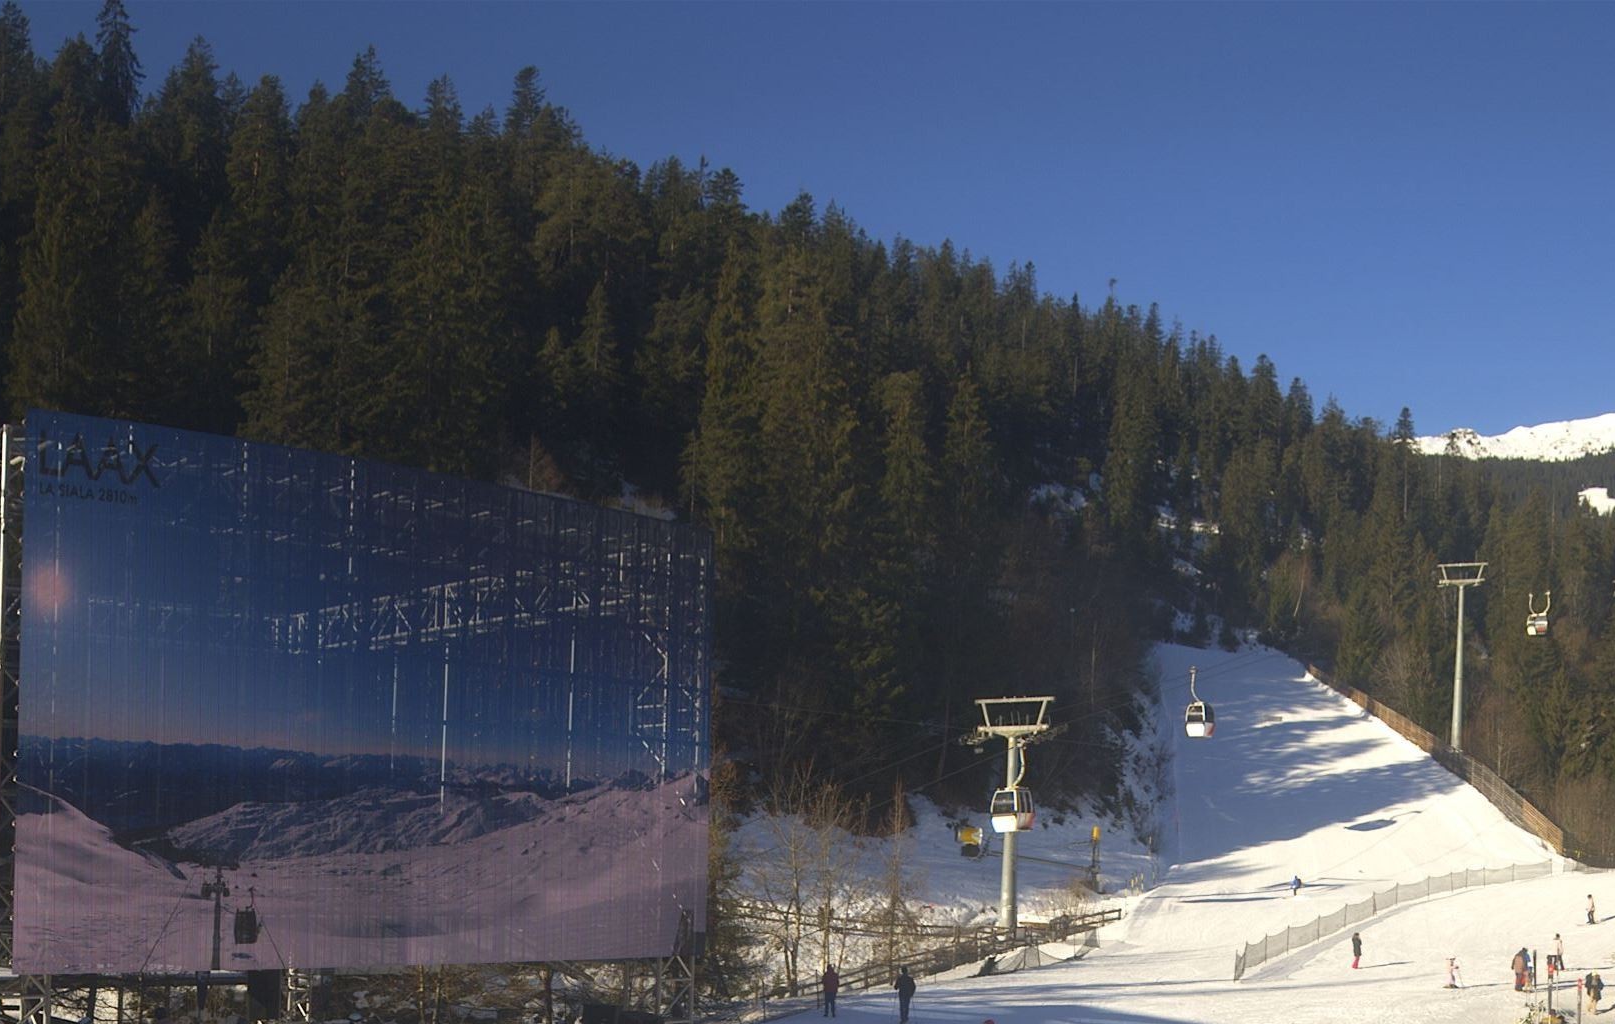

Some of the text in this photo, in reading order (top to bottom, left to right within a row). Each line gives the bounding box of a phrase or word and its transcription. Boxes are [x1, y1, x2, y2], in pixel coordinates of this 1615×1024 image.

[38, 428, 161, 490] LAAX
[39, 482, 55, 496] LA
[59, 485, 95, 500] SIALA
